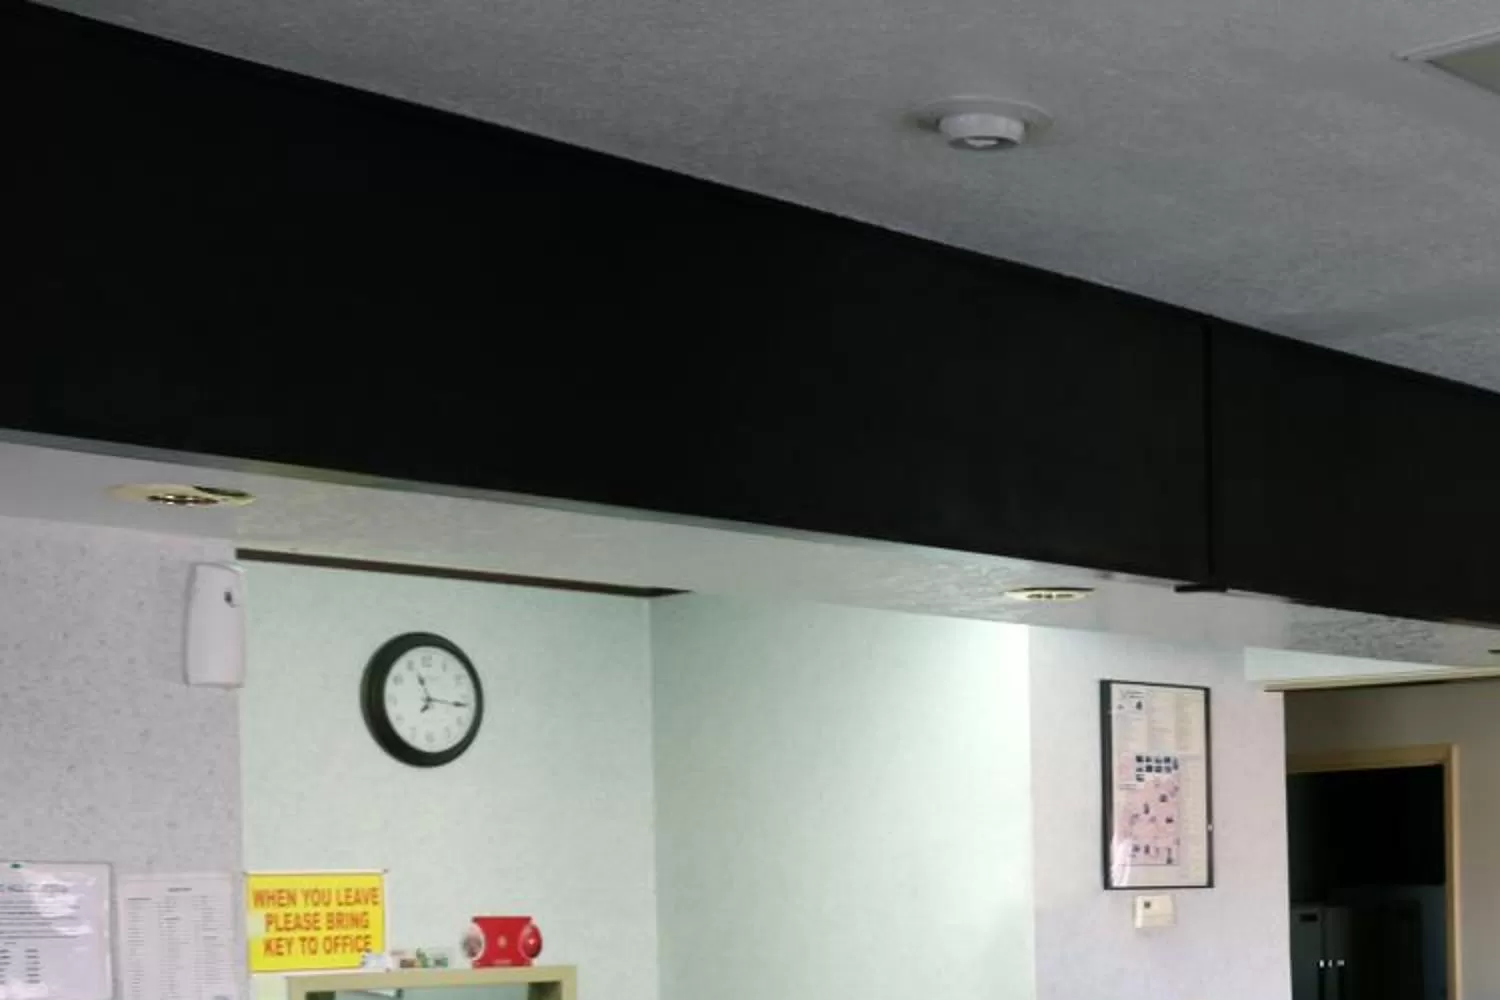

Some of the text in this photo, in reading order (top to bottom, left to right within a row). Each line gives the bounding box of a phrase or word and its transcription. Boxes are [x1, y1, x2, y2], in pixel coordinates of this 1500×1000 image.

[252, 887, 380, 909] WHEN YOU LEAVE
[264, 911, 369, 932] PLEASE BRING
[263, 934, 373, 956] KEY TO OFFICE
